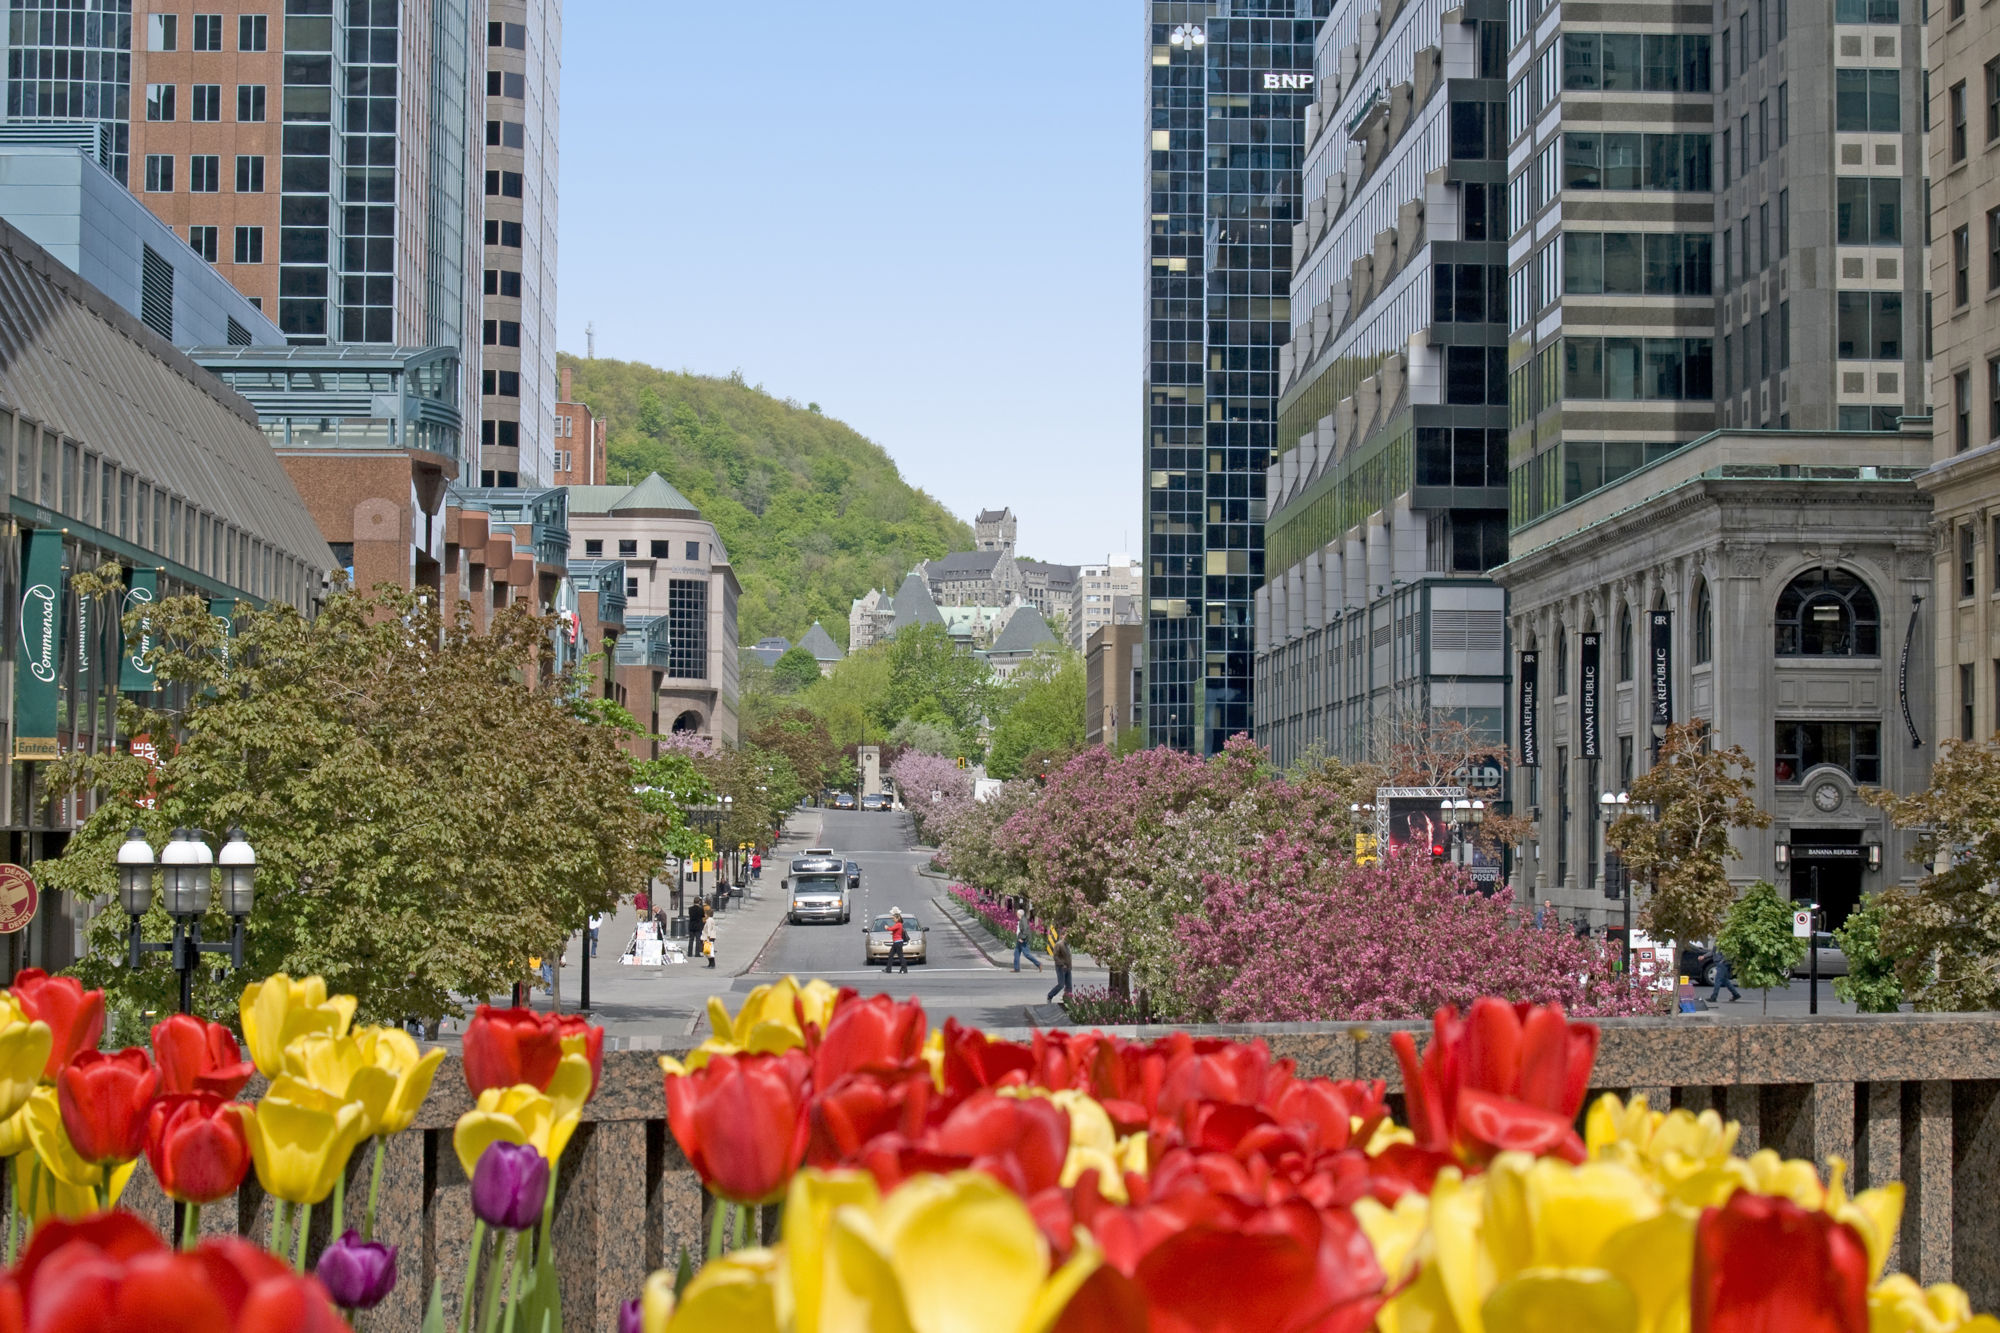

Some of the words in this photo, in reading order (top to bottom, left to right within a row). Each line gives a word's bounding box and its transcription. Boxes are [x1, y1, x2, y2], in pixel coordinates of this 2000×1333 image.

[1263, 73, 1315, 89] BNP
[21, 584, 56, 682] Commensal
[120, 587, 153, 674] Cmmenl
[1585, 666, 1595, 715] REPUBLIC
[1657, 648, 1666, 700] REPUBLIC
[1524, 681, 1533, 726] REPUBLIC
[1657, 702, 1668, 746] BANA
[18, 741, 56, 754] Entrée
[1524, 727, 1534, 764] BANANA
[1586, 715, 1595, 756] BANANA
